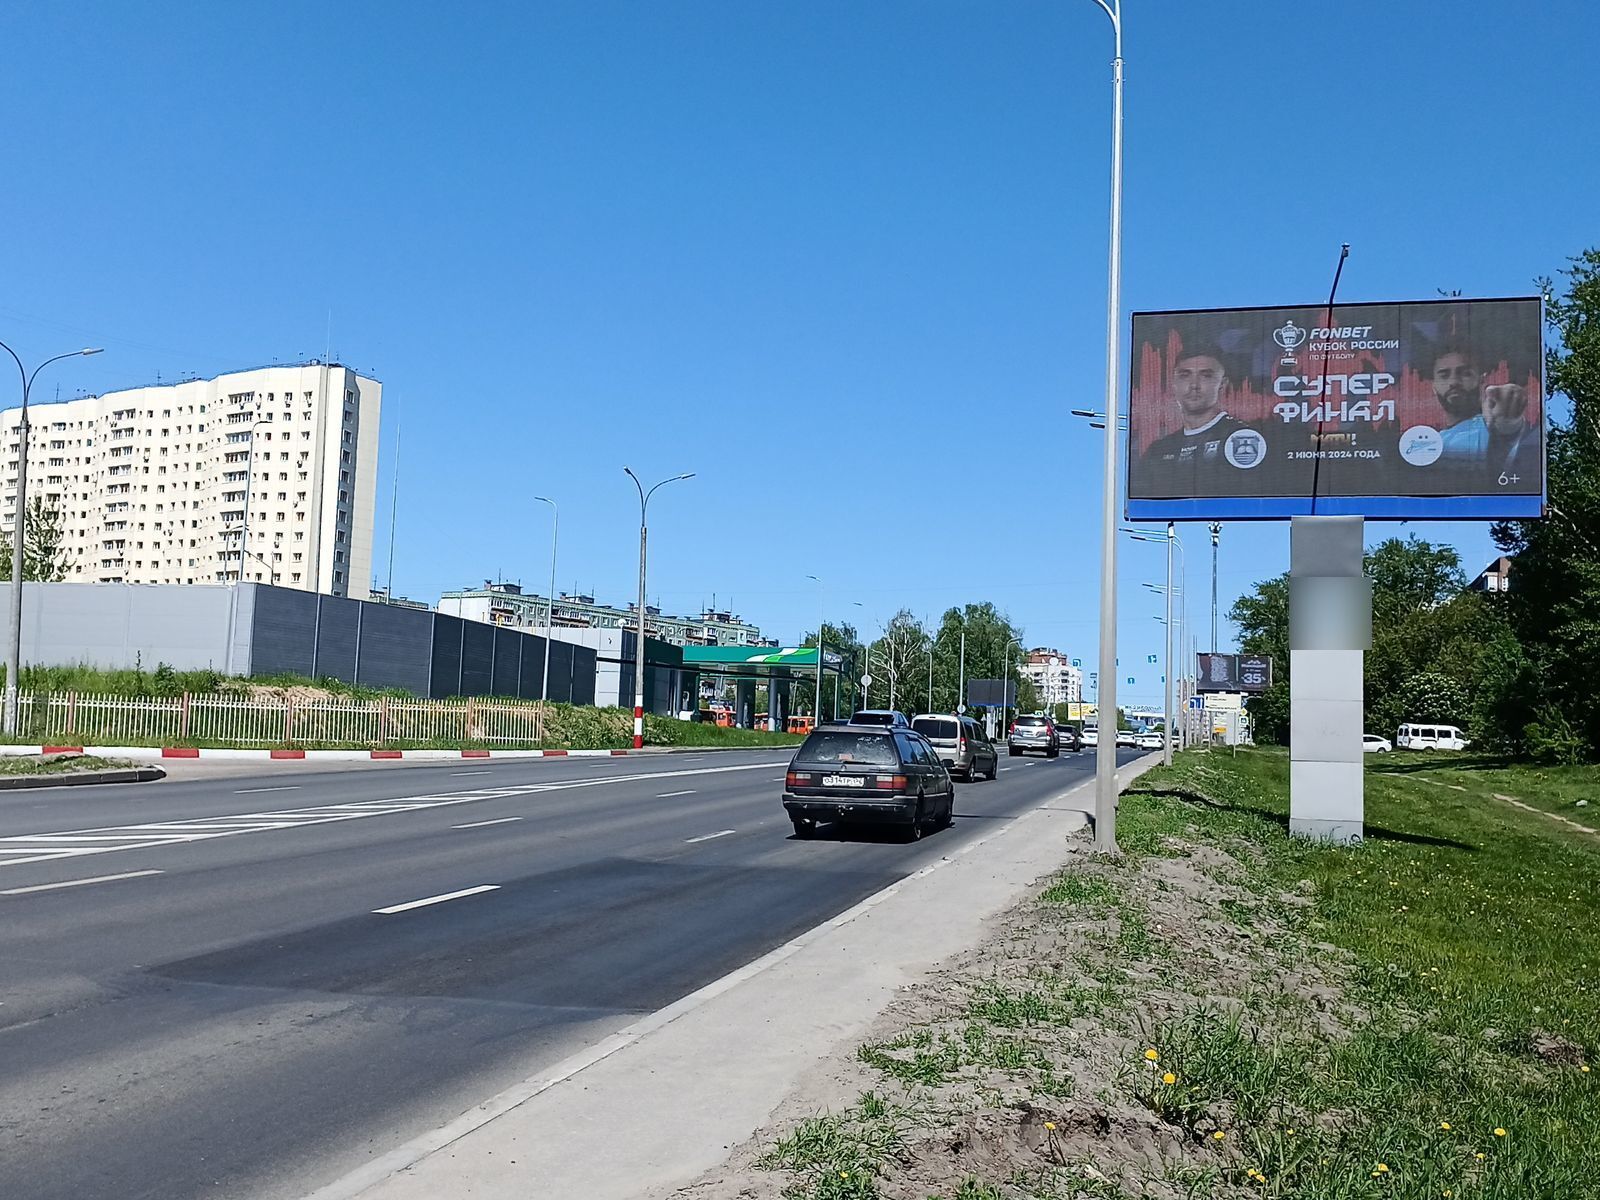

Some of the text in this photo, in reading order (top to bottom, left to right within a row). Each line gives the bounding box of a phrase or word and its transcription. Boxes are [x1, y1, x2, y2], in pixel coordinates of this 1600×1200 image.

[1309, 326, 1372, 340] FONBET
[1309, 339, 1399, 352] КУБОК РОССИИ
[1273, 373, 1395, 397] СУПЕР
[1273, 400, 1395, 423] ФИНАЛ
[1287, 449, 1381, 460] 2 ИЮНЯ 2024 ГОДА
[1498, 471, 1520, 486] 6+
